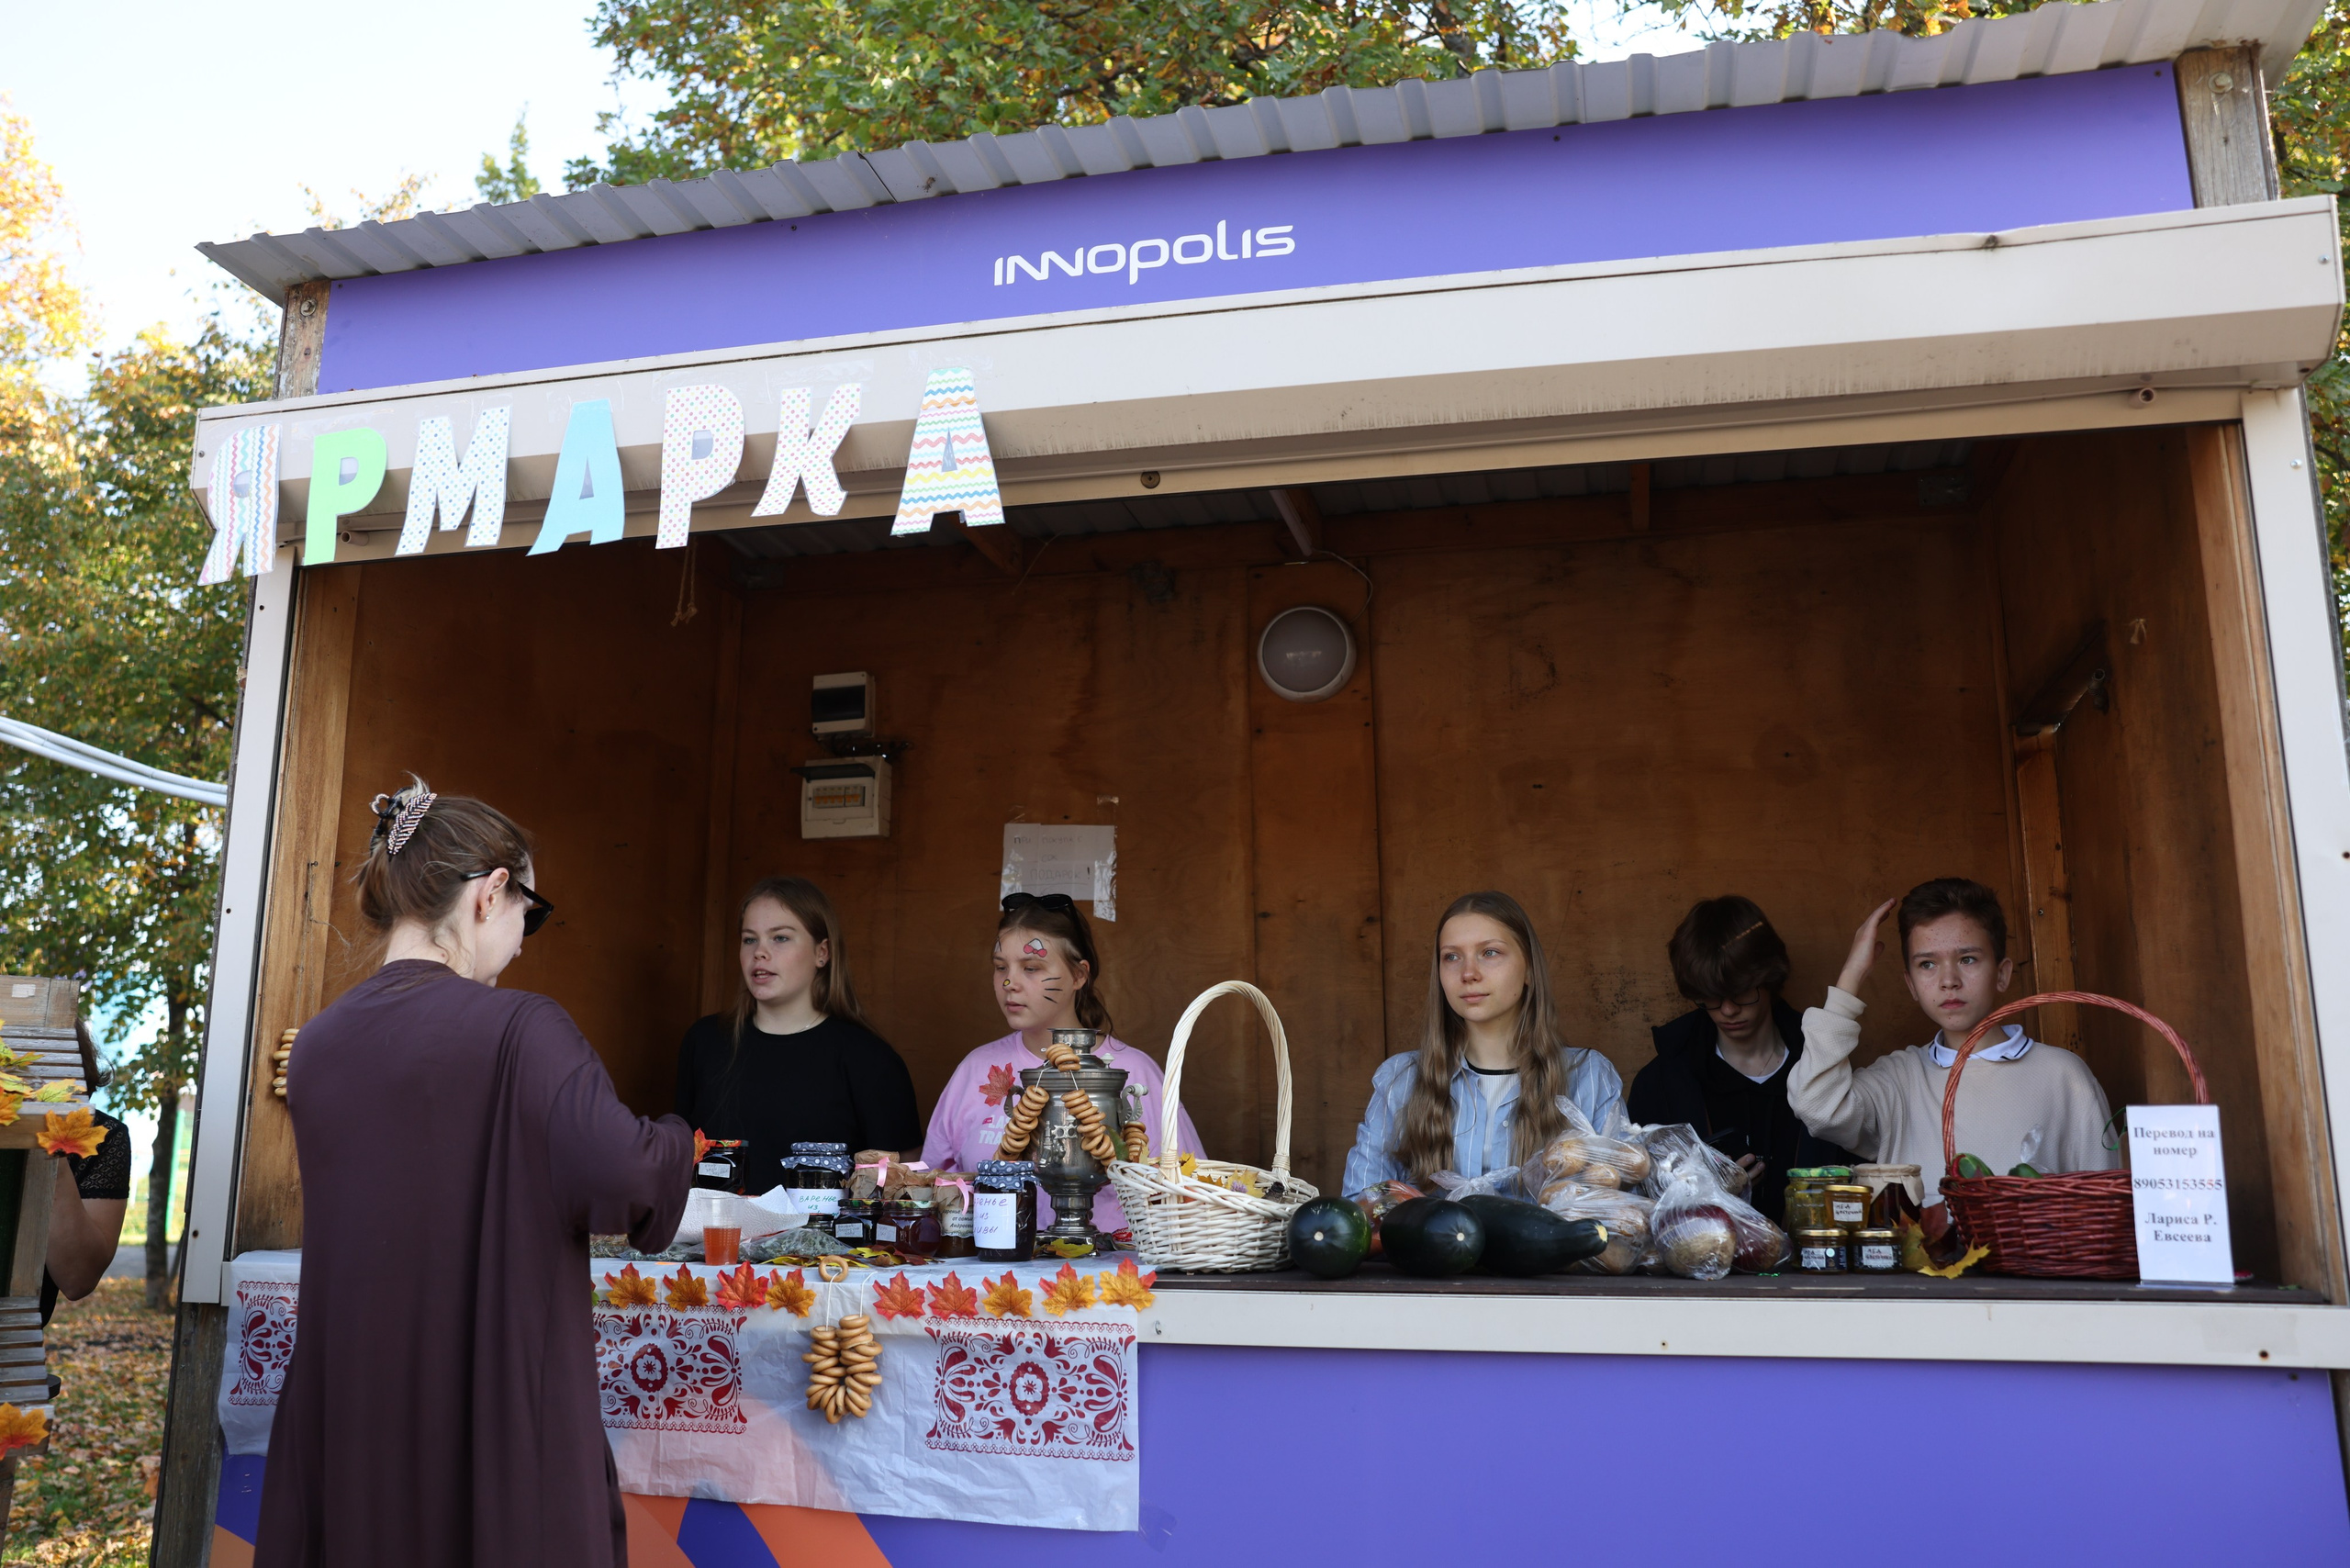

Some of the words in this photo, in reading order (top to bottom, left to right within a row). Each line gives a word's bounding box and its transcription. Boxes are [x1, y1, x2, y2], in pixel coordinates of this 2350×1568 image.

[197, 366, 1005, 586] ЯРМАРКА
[988, 1114, 1011, 1129] LA
[979, 1130, 1005, 1145] TRA
[2133, 1127, 2194, 1141] Перевод
[2198, 1129, 2216, 1138] на
[2154, 1147, 2198, 1159] номер
[2133, 1178, 2223, 1191] 89053153555
[2144, 1213, 2199, 1227] Лариса
[2204, 1214, 2218, 1226] Р.
[2154, 1230, 2212, 1243] Евсеева
